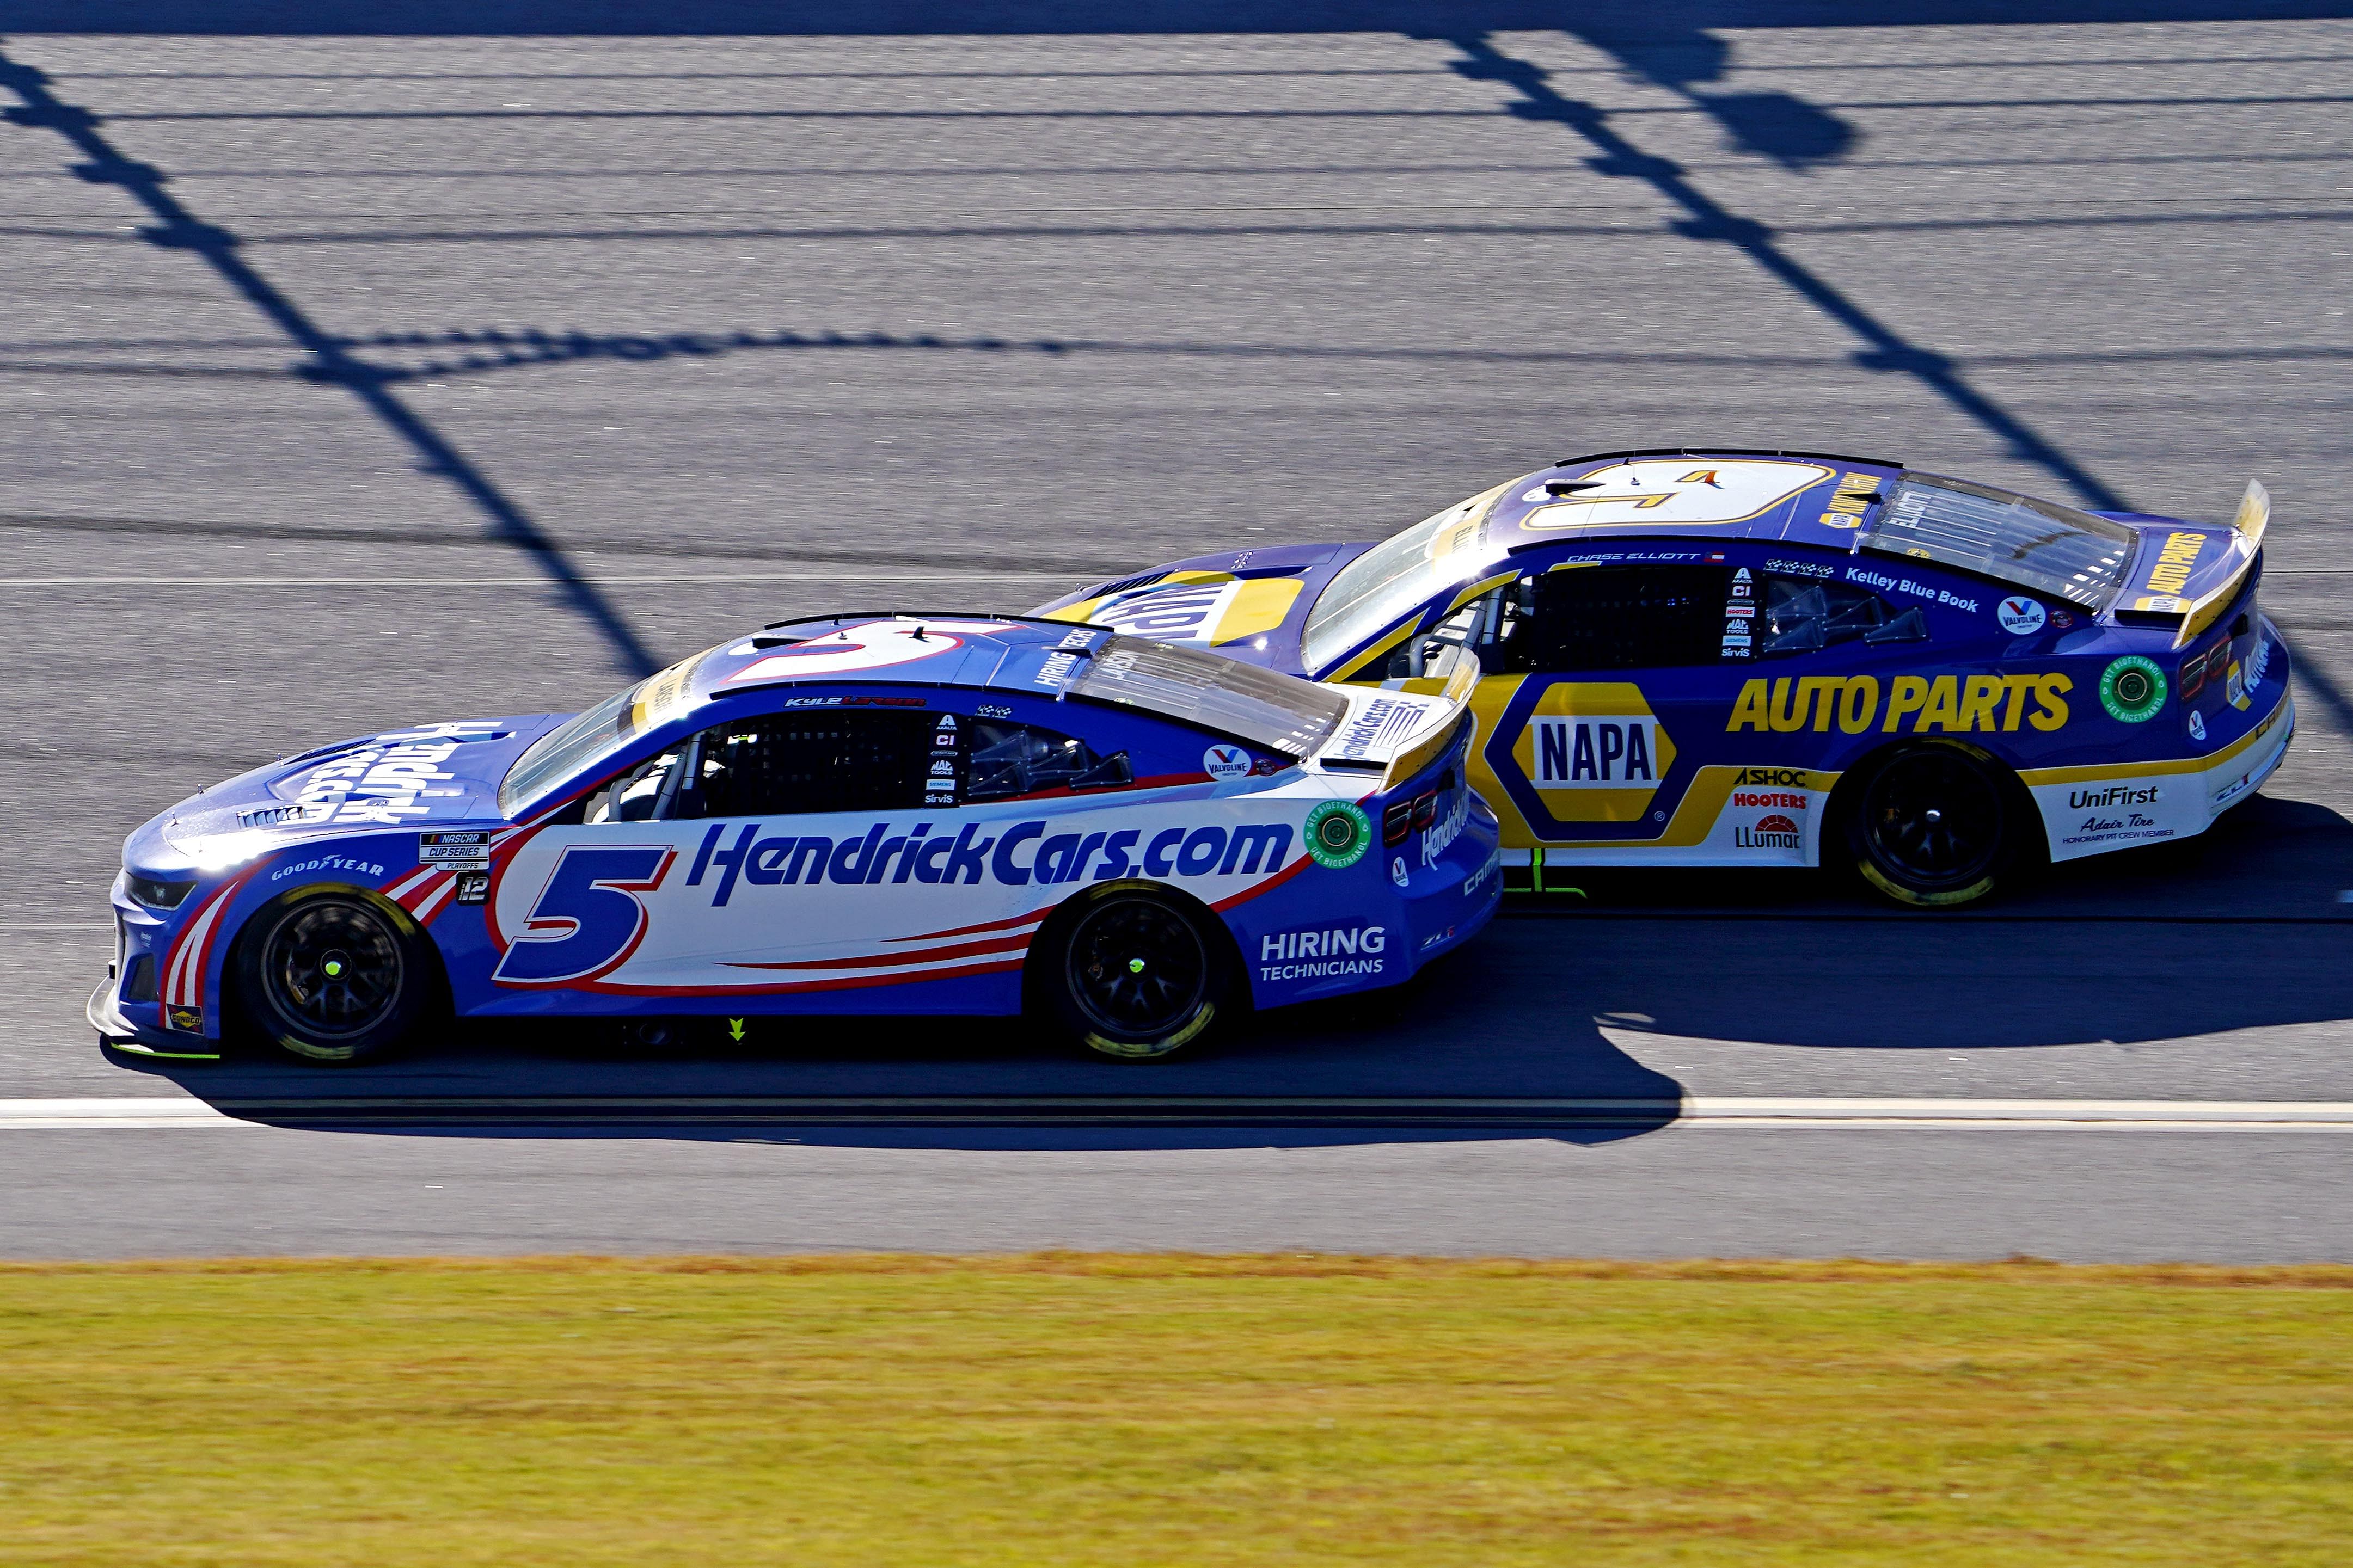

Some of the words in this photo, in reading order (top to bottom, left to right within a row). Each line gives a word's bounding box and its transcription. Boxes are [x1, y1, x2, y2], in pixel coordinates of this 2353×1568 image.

[1567, 553, 1625, 562] CHASE
[2158, 532, 2207, 565] PARTS
[1846, 568, 1897, 591] Kelley
[1899, 580, 1936, 598] Blue
[1938, 590, 1980, 613] Book
[2146, 563, 2192, 595] AUTO
[1732, 586, 1751, 597] CI
[2003, 614, 2042, 626] VALVOLINE
[1034, 651, 1077, 687] HIRING
[2103, 668, 2115, 682] GET
[2113, 657, 2160, 676] BIOETHANOL
[1725, 675, 1879, 734] AUTO
[1881, 672, 2074, 733] PARTS
[2107, 702, 2121, 715] GET
[2119, 697, 2164, 723] BIOETHANOL
[936, 735, 955, 745] CI
[1541, 723, 1652, 781] NAPA
[1208, 763, 1247, 774] VALVOLINE
[1733, 768, 1806, 787] ASHOC
[1733, 793, 1806, 809] HOOTERS
[2070, 785, 2159, 809] UniFirst
[1307, 813, 1318, 827] GET
[1318, 802, 1364, 822] BIOETHANOL
[2080, 817, 2123, 832] Adair
[2129, 814, 2154, 827] Tire
[442, 834, 479, 843] NASCAR
[2063, 834, 2105, 844] HONORARY
[2119, 831, 2140, 839] CREW
[2142, 829, 2174, 838] MEMBER
[428, 847, 448, 856] CUP
[450, 847, 480, 856] SERIES
[1310, 847, 1324, 860] GET
[1323, 841, 1368, 866] BIOETHANOL
[685, 821, 1295, 907] HendrickCars.com
[462, 877, 489, 900] 12
[491, 844, 678, 983] 5
[1261, 926, 1386, 961] HIRING
[1260, 959, 1384, 981] TECHNICIANS
[171, 1014, 201, 1024] SUNOCO
